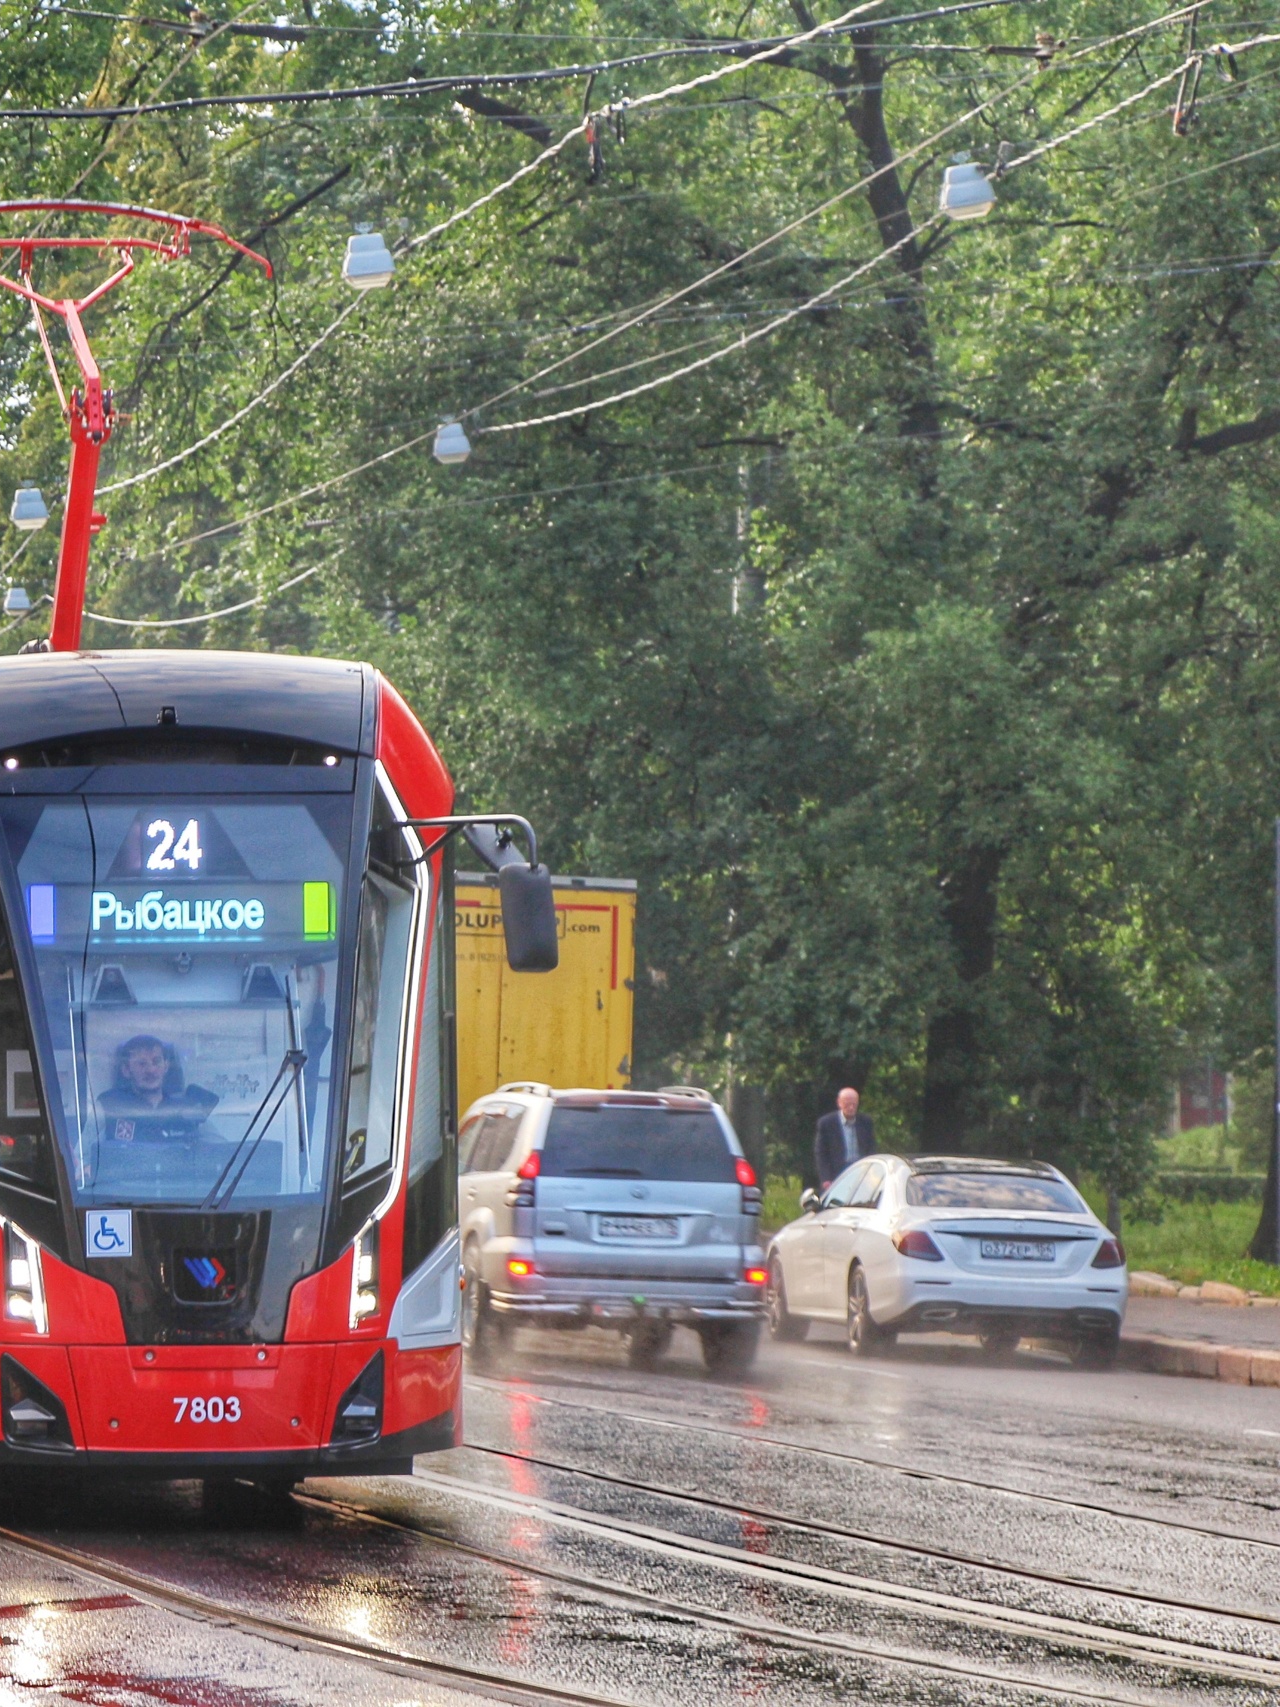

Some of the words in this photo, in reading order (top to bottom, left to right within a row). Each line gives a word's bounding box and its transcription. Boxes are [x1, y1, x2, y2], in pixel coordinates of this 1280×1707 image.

[146, 818, 203, 870] 24
[91, 889, 265, 935] Рыбацкое
[567, 923, 601, 933] .com
[173, 1395, 242, 1424] 7803
